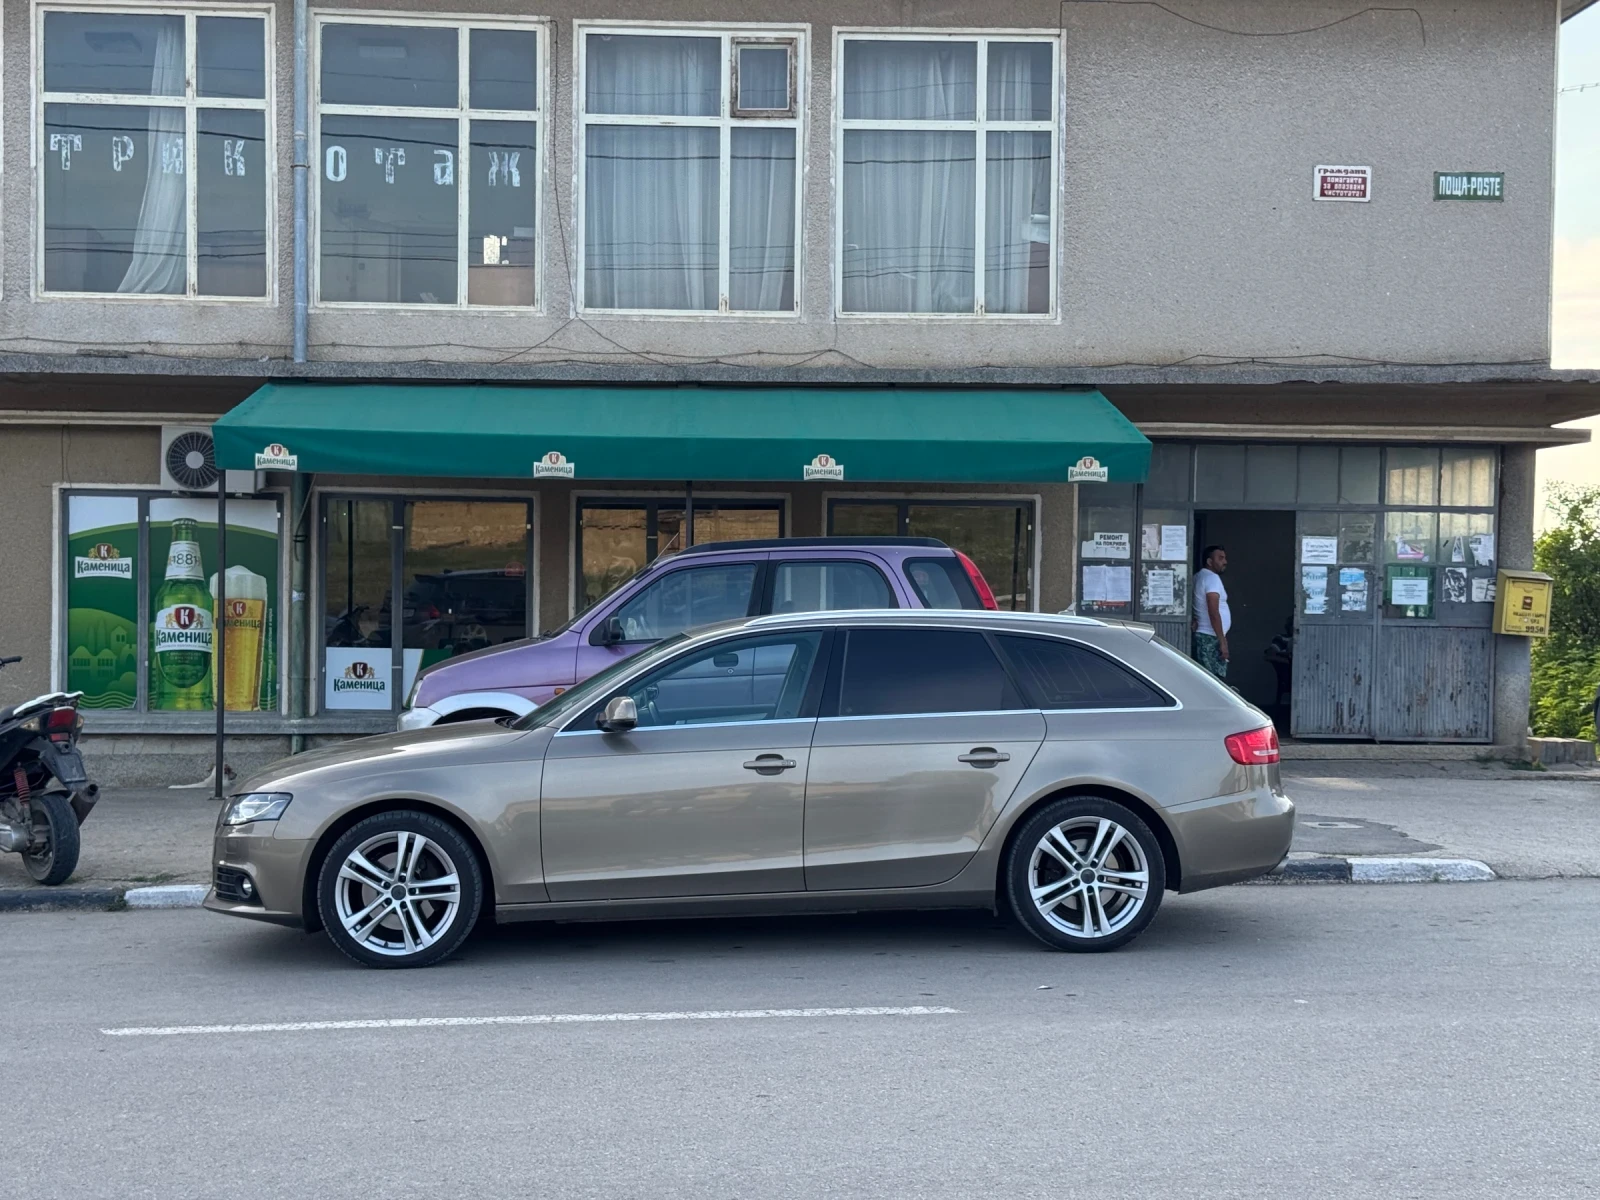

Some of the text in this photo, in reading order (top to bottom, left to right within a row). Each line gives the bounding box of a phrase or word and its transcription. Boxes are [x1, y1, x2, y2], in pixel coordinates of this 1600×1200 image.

[1439, 176, 1500, 196] ПОЩА-POSTE
[257, 456, 296, 467] Каменица
[535, 464, 573, 474] Каменица
[805, 467, 842, 477] Каменица
[1069, 469, 1106, 479] Каменица
[77, 560, 131, 574] Каменица
[156, 630, 212, 646] Каменица
[334, 678, 385, 692] Каменица
